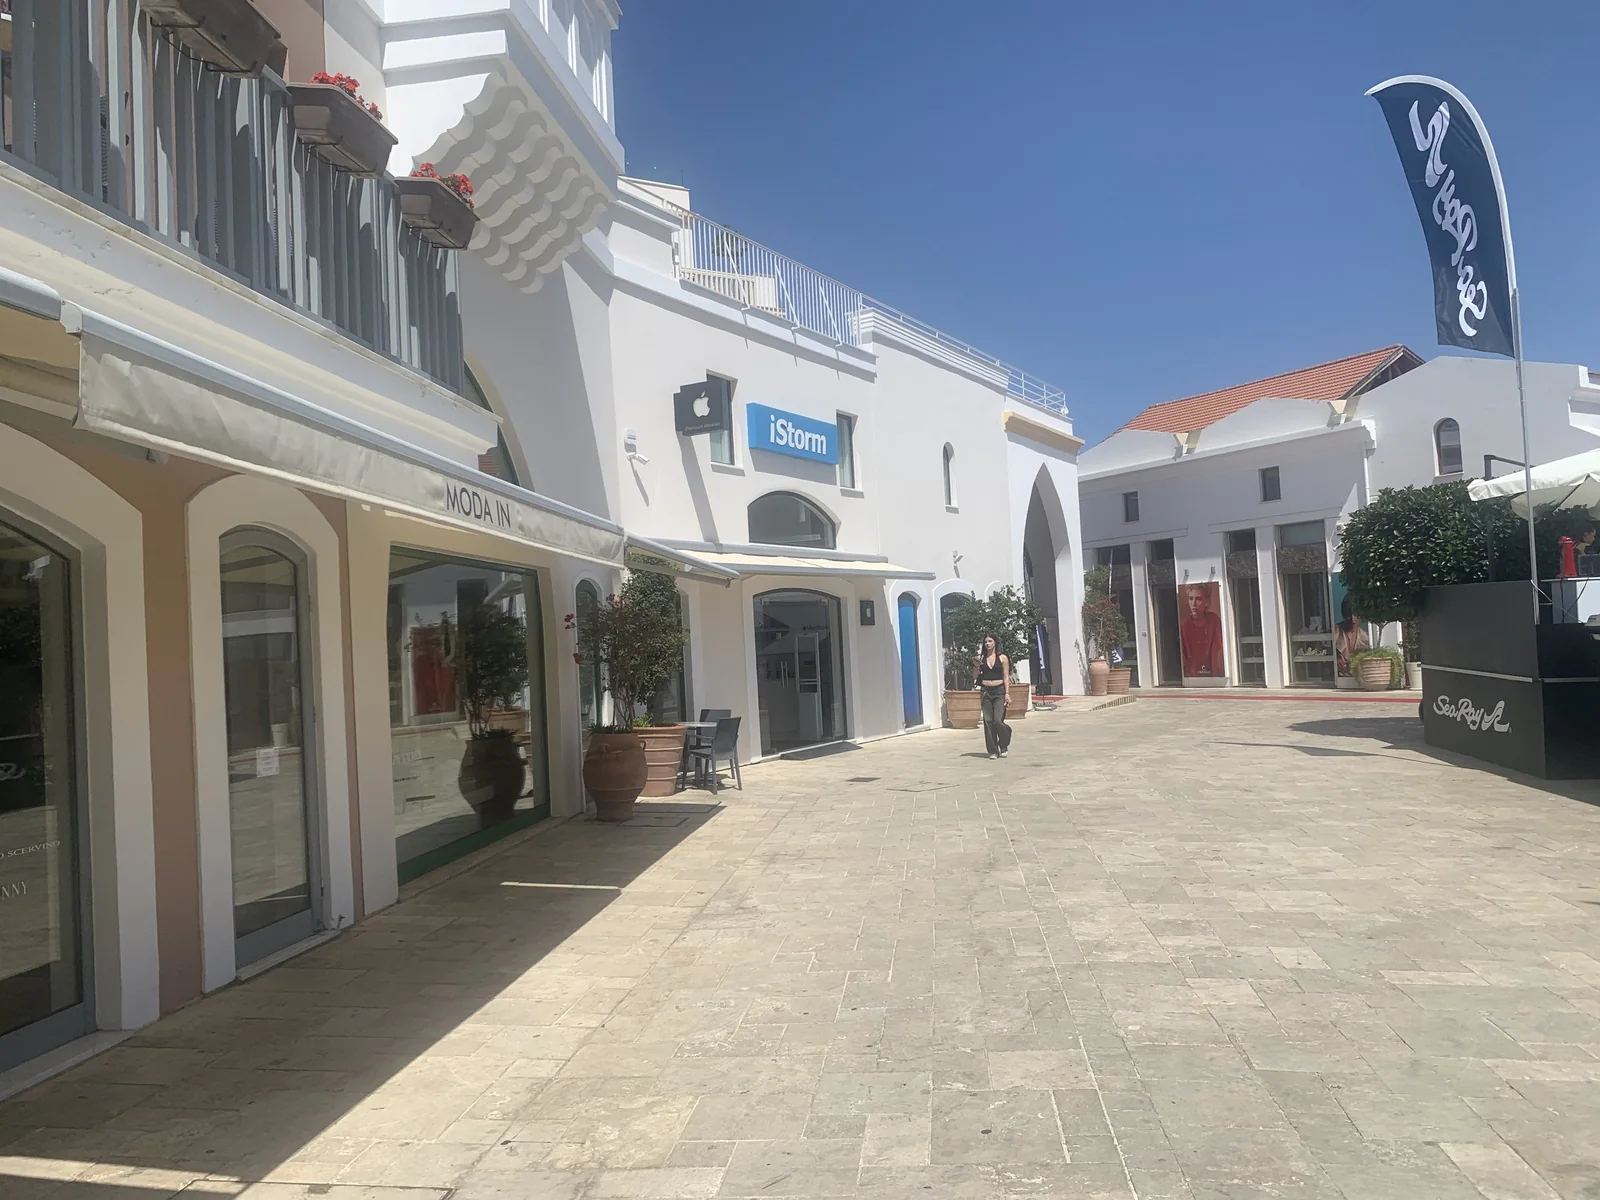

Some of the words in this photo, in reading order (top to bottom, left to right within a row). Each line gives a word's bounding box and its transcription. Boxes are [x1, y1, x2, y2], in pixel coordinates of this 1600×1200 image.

[769, 414, 827, 455] iStorm
[446, 481, 494, 524] MODA
[496, 499, 512, 529] IN
[7, 840, 61, 858] SCERVINO
